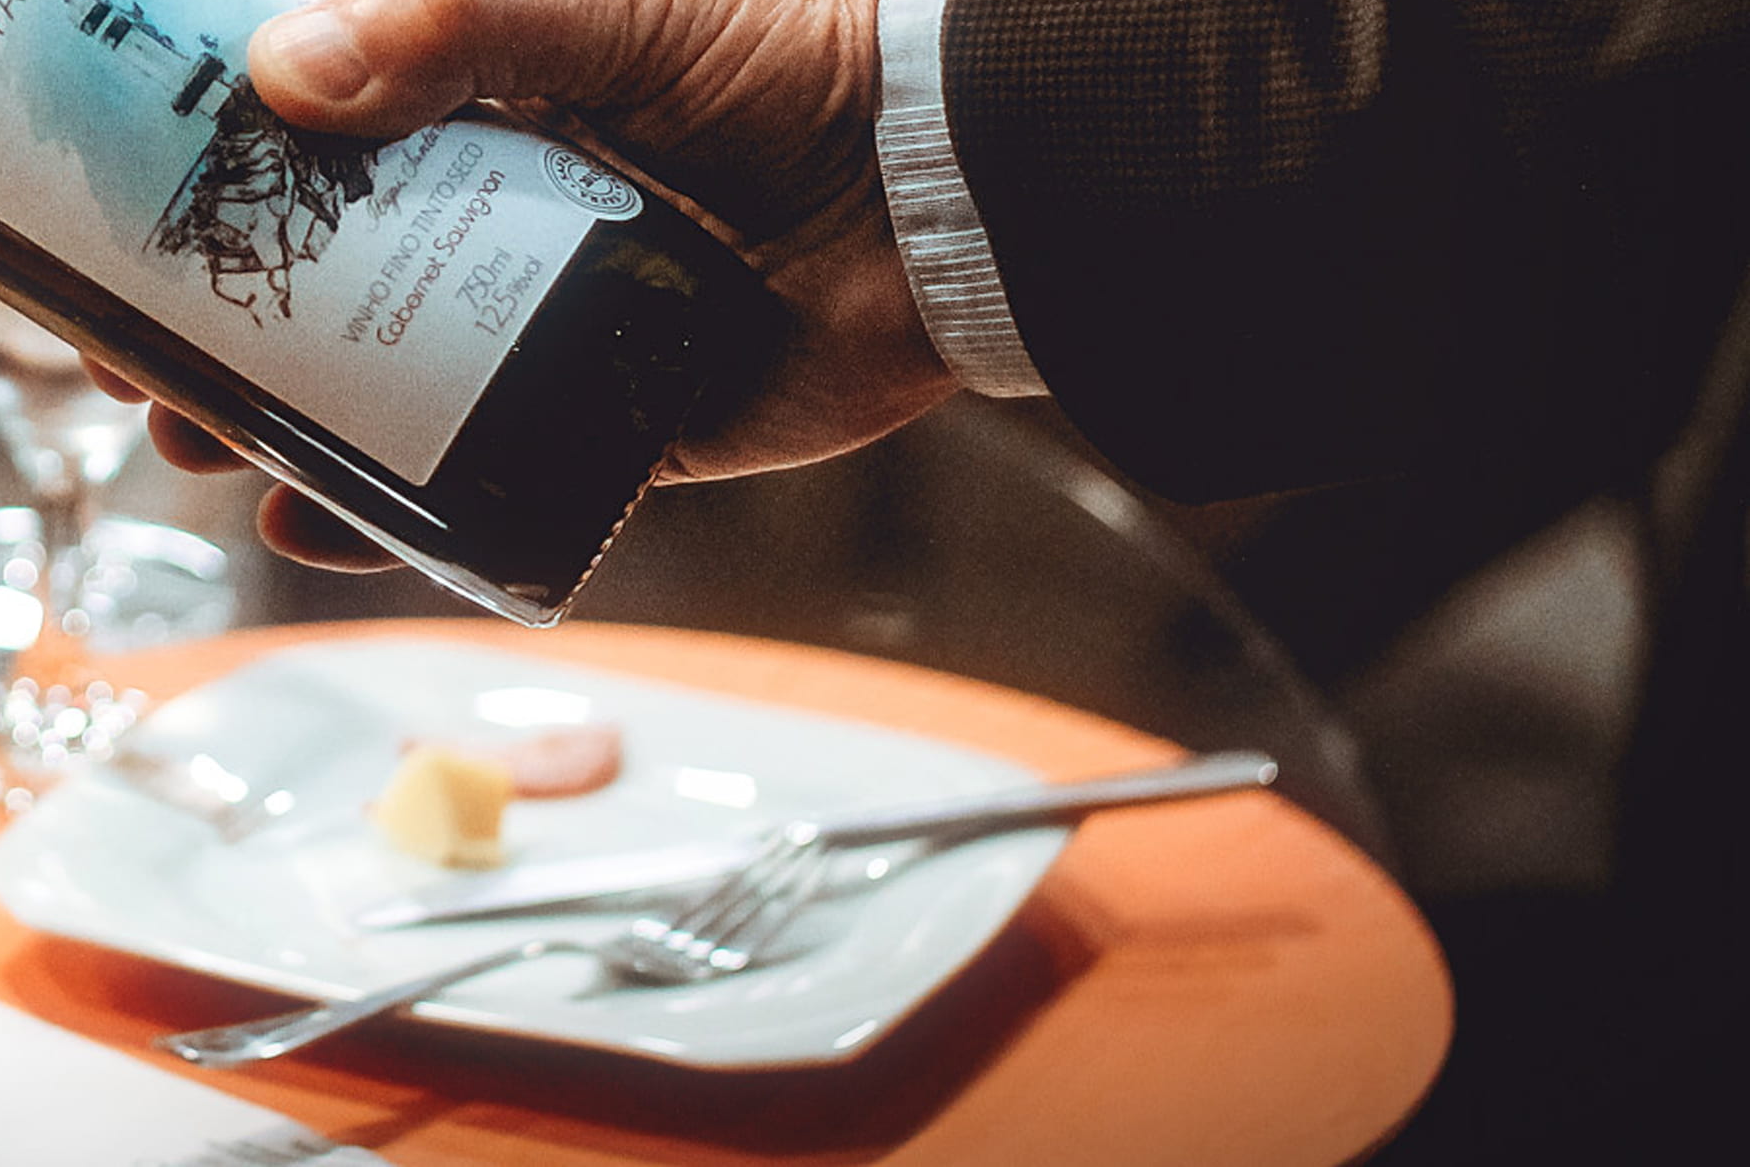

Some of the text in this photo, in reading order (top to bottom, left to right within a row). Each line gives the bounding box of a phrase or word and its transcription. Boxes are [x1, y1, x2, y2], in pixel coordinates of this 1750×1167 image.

[340, 141, 484, 344] VINHO FINO TINTO SECO
[376, 170, 506, 346] Cabernet Sauvignon
[455, 245, 513, 310] 750ml
